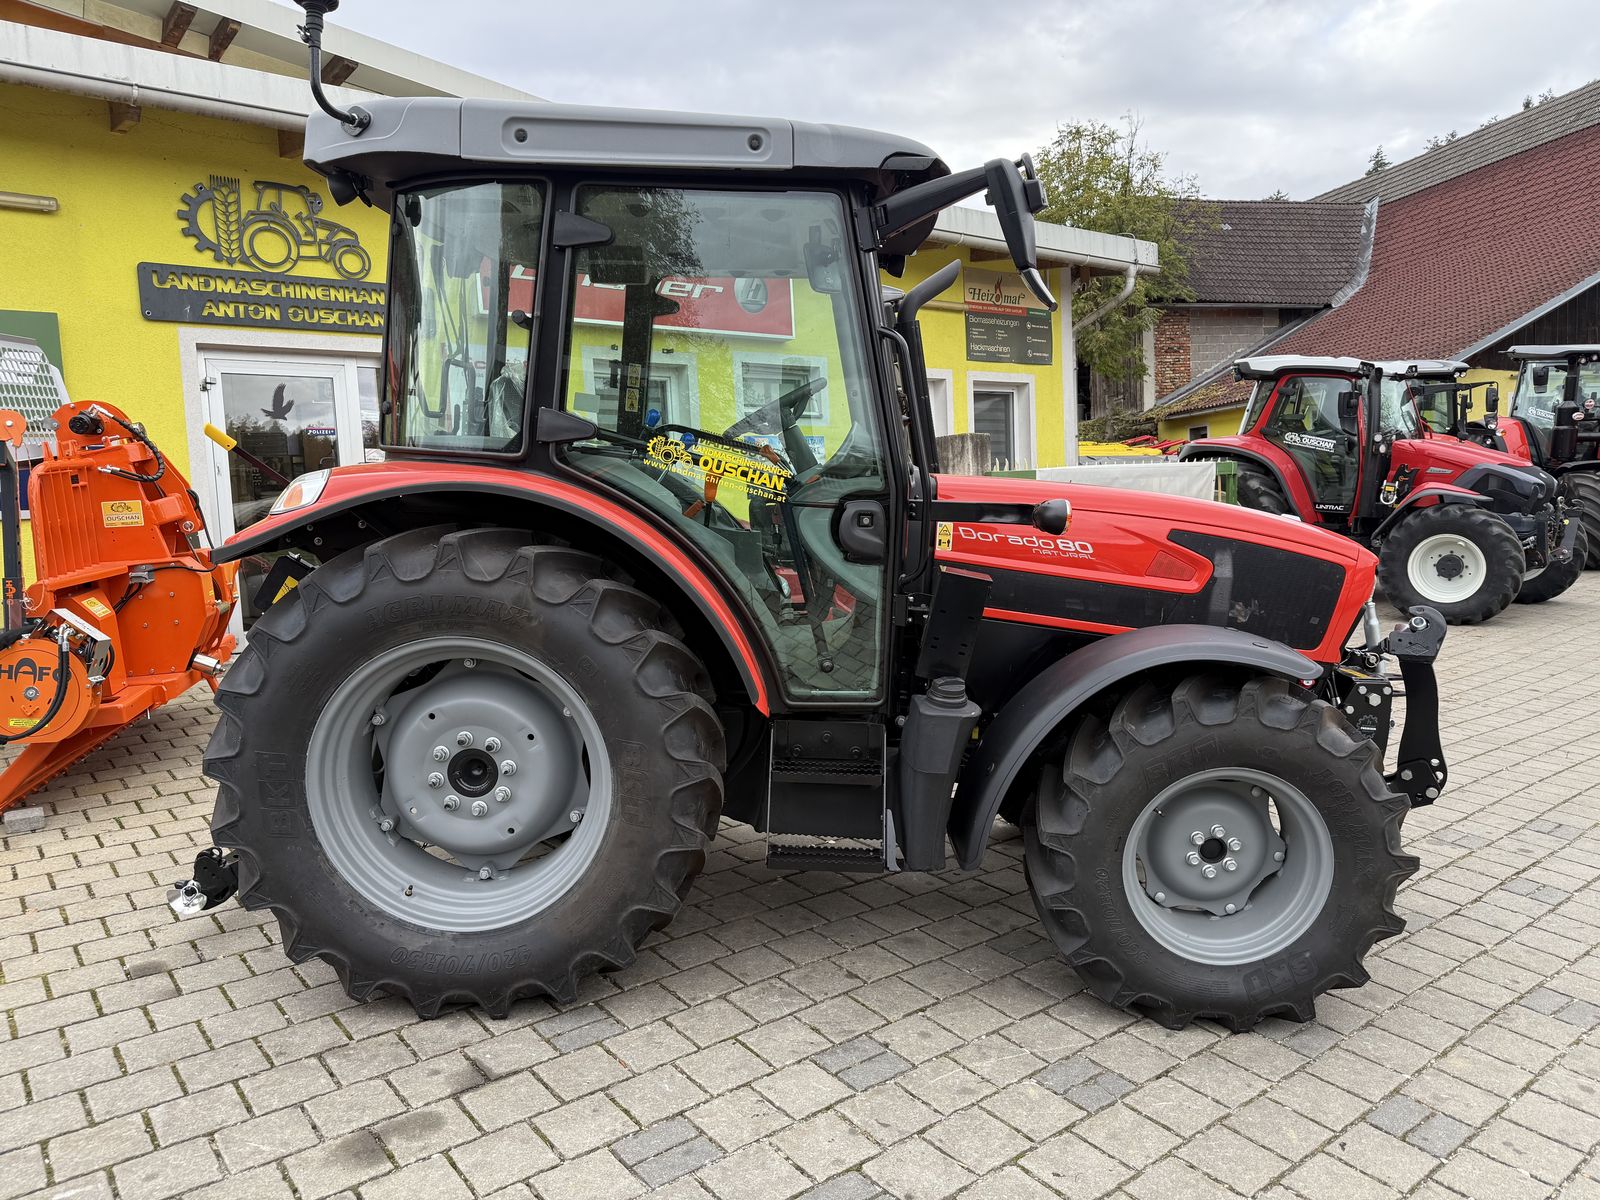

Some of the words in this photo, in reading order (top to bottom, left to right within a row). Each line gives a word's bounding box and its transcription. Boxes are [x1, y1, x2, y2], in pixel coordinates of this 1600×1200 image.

[202, 299, 280, 321] ANTON
[288, 306, 384, 327] OUSCHAN
[969, 315, 1019, 327] Biomasseheizungen
[970, 343, 1010, 352] Hackmaschinen
[1302, 437, 1335, 449] OUSCHAN
[692, 444, 792, 478] LANDMASCHINENHANDEL
[699, 455, 785, 491] OUSCHAN
[643, 458, 786, 503] www.landmaschinen-ouschan.at
[958, 526, 1055, 549] Dorado
[1056, 539, 1094, 554] 80
[1033, 548, 1096, 560] NATURAL
